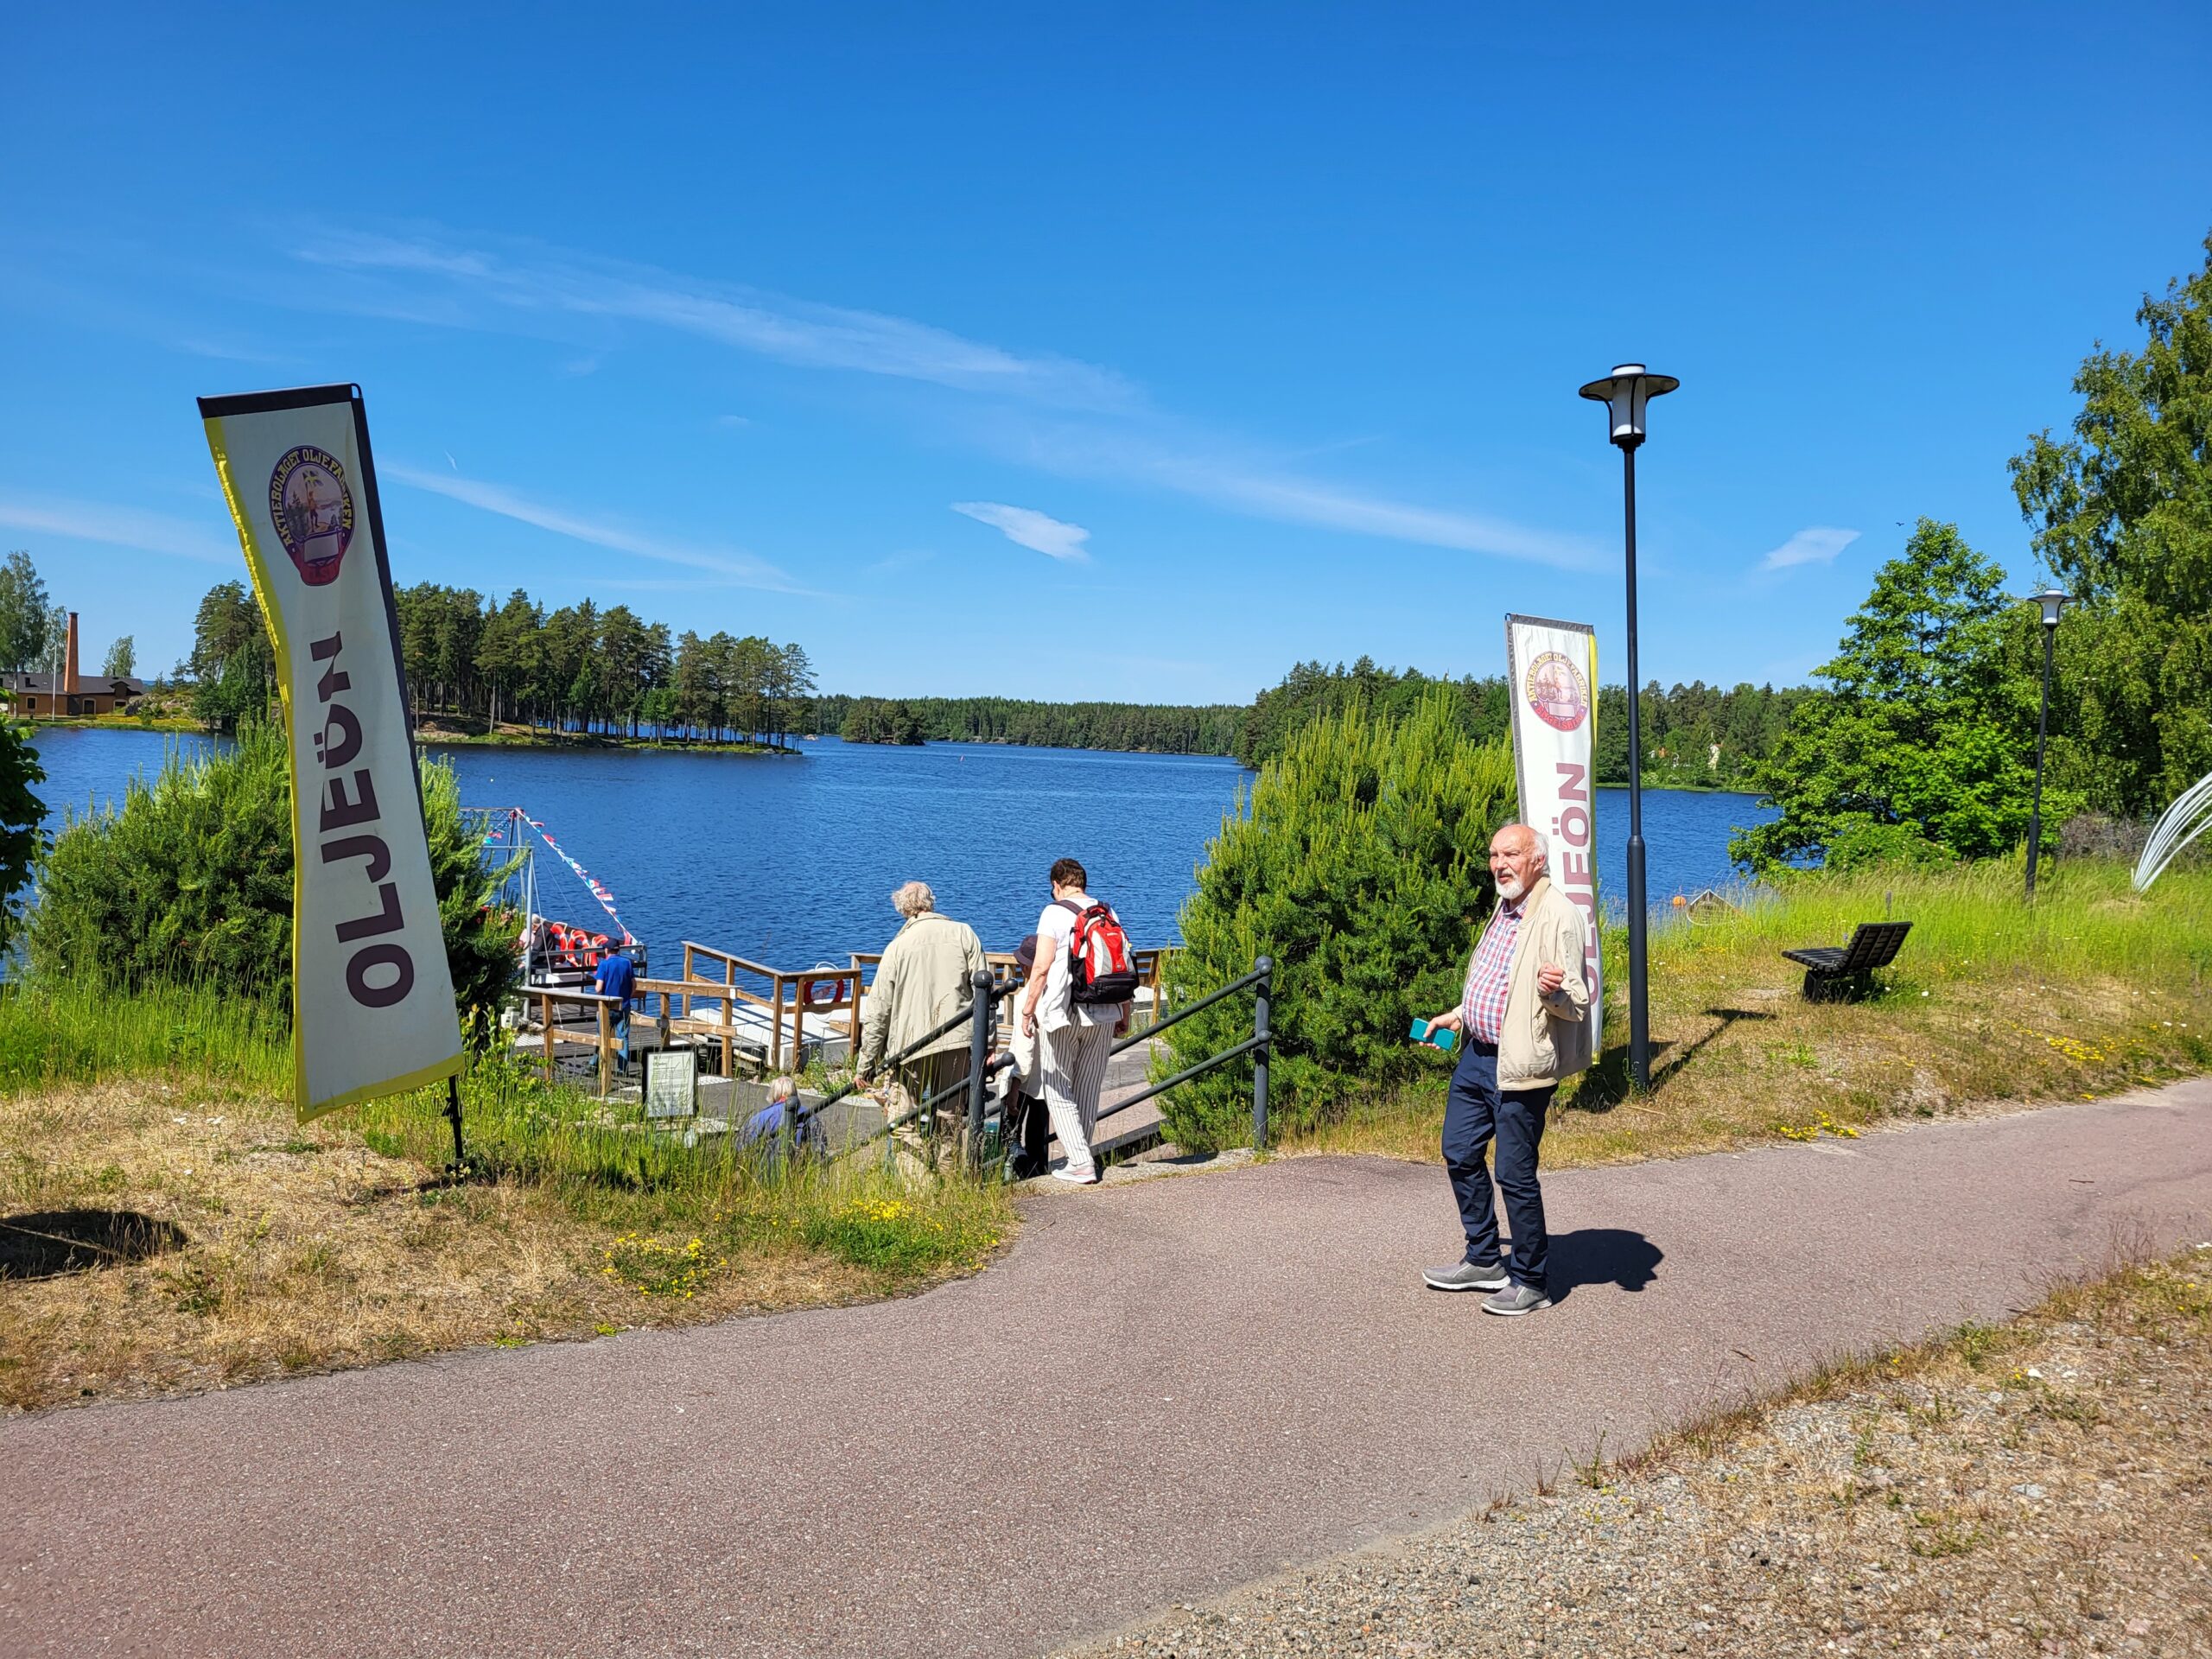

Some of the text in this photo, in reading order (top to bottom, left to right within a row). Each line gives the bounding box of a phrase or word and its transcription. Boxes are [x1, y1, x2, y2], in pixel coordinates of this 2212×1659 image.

[271, 449, 353, 546] AKTIEBOLAGET OLJEFAKEN
[1527, 653, 1552, 702] AKTIEBOLAGET
[310, 631, 414, 1007] OLJEÖN
